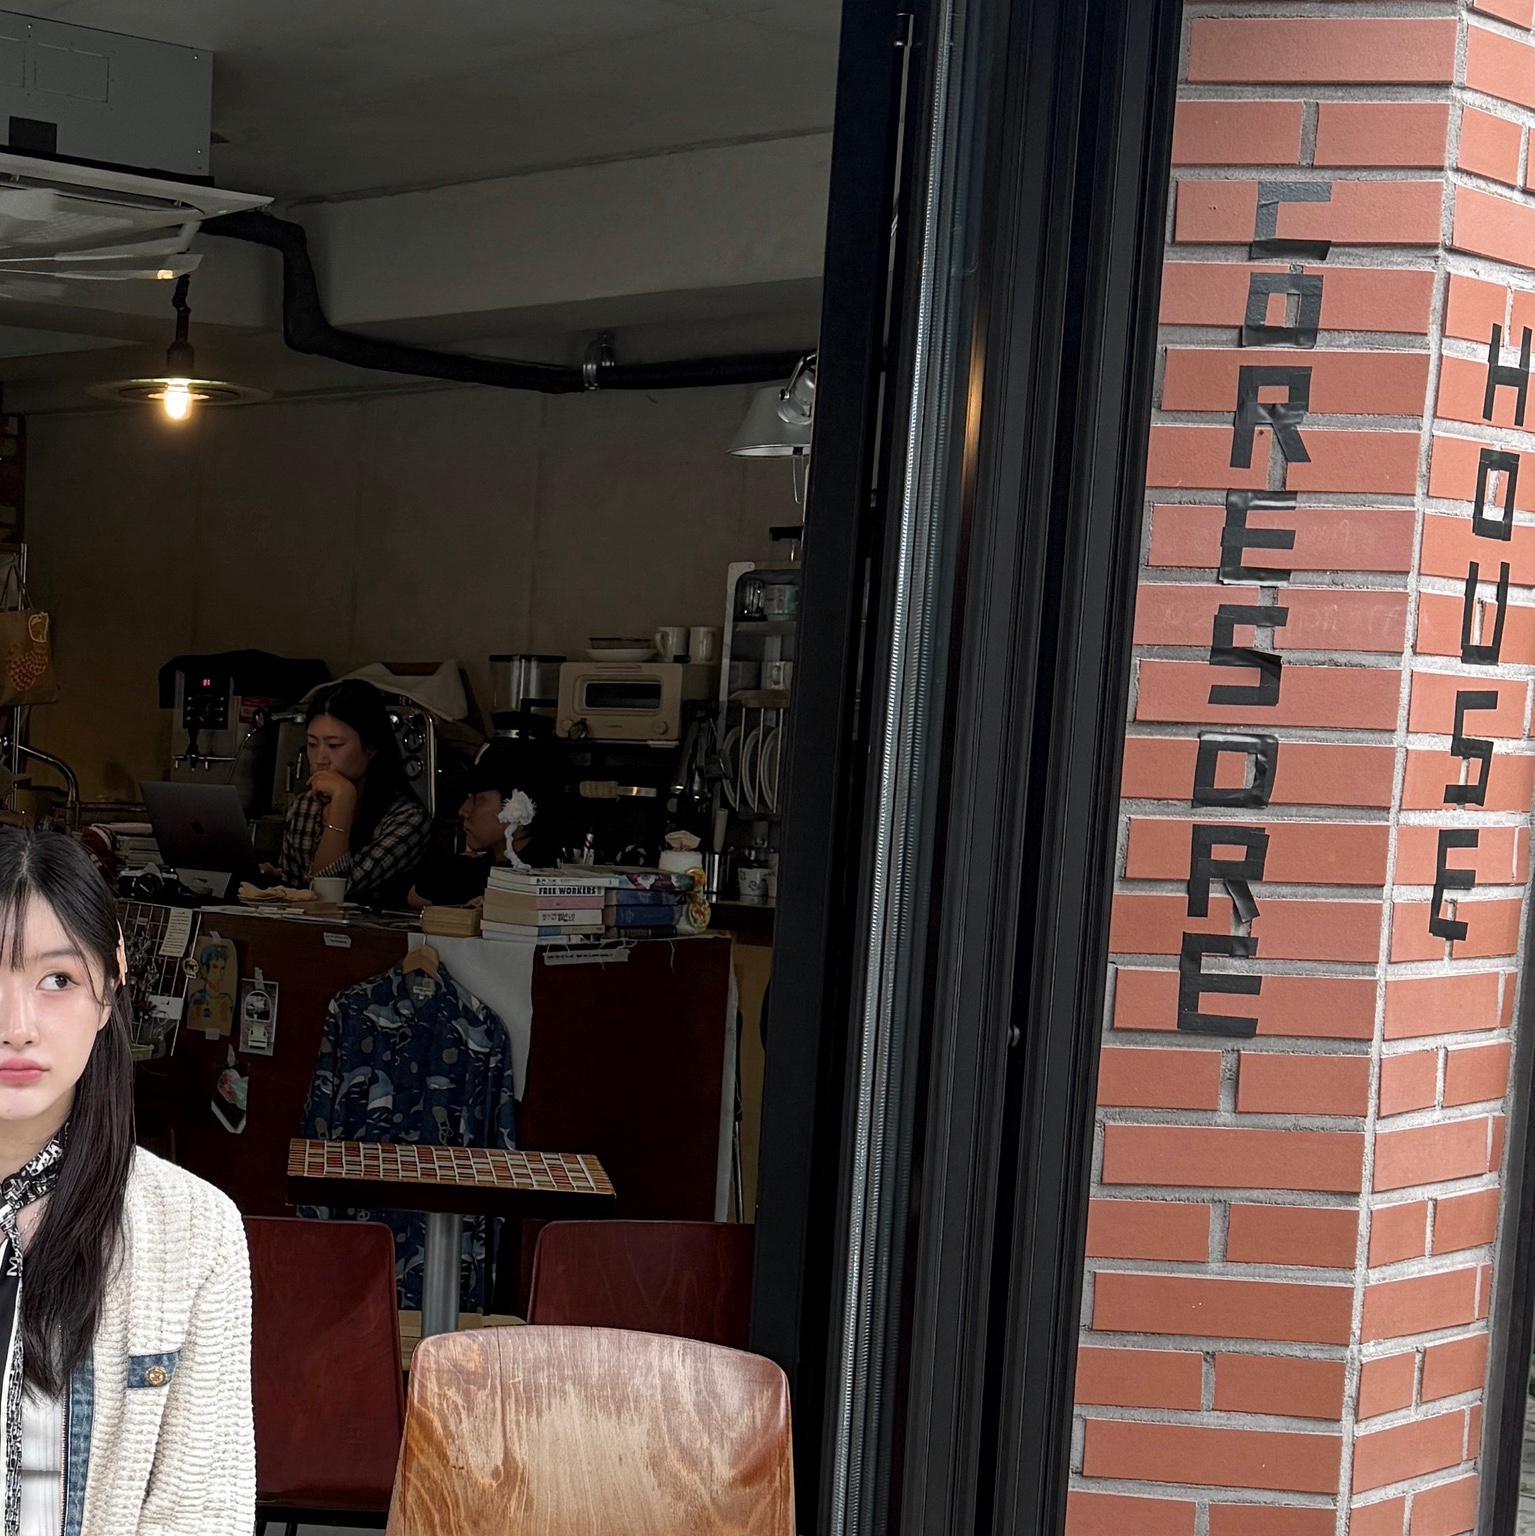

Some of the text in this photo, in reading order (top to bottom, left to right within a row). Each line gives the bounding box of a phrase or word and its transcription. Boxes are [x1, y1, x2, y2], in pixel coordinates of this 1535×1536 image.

[1429, 322, 1533, 941] HOUSE
[538, 886, 597, 896] FREE WORKERS
